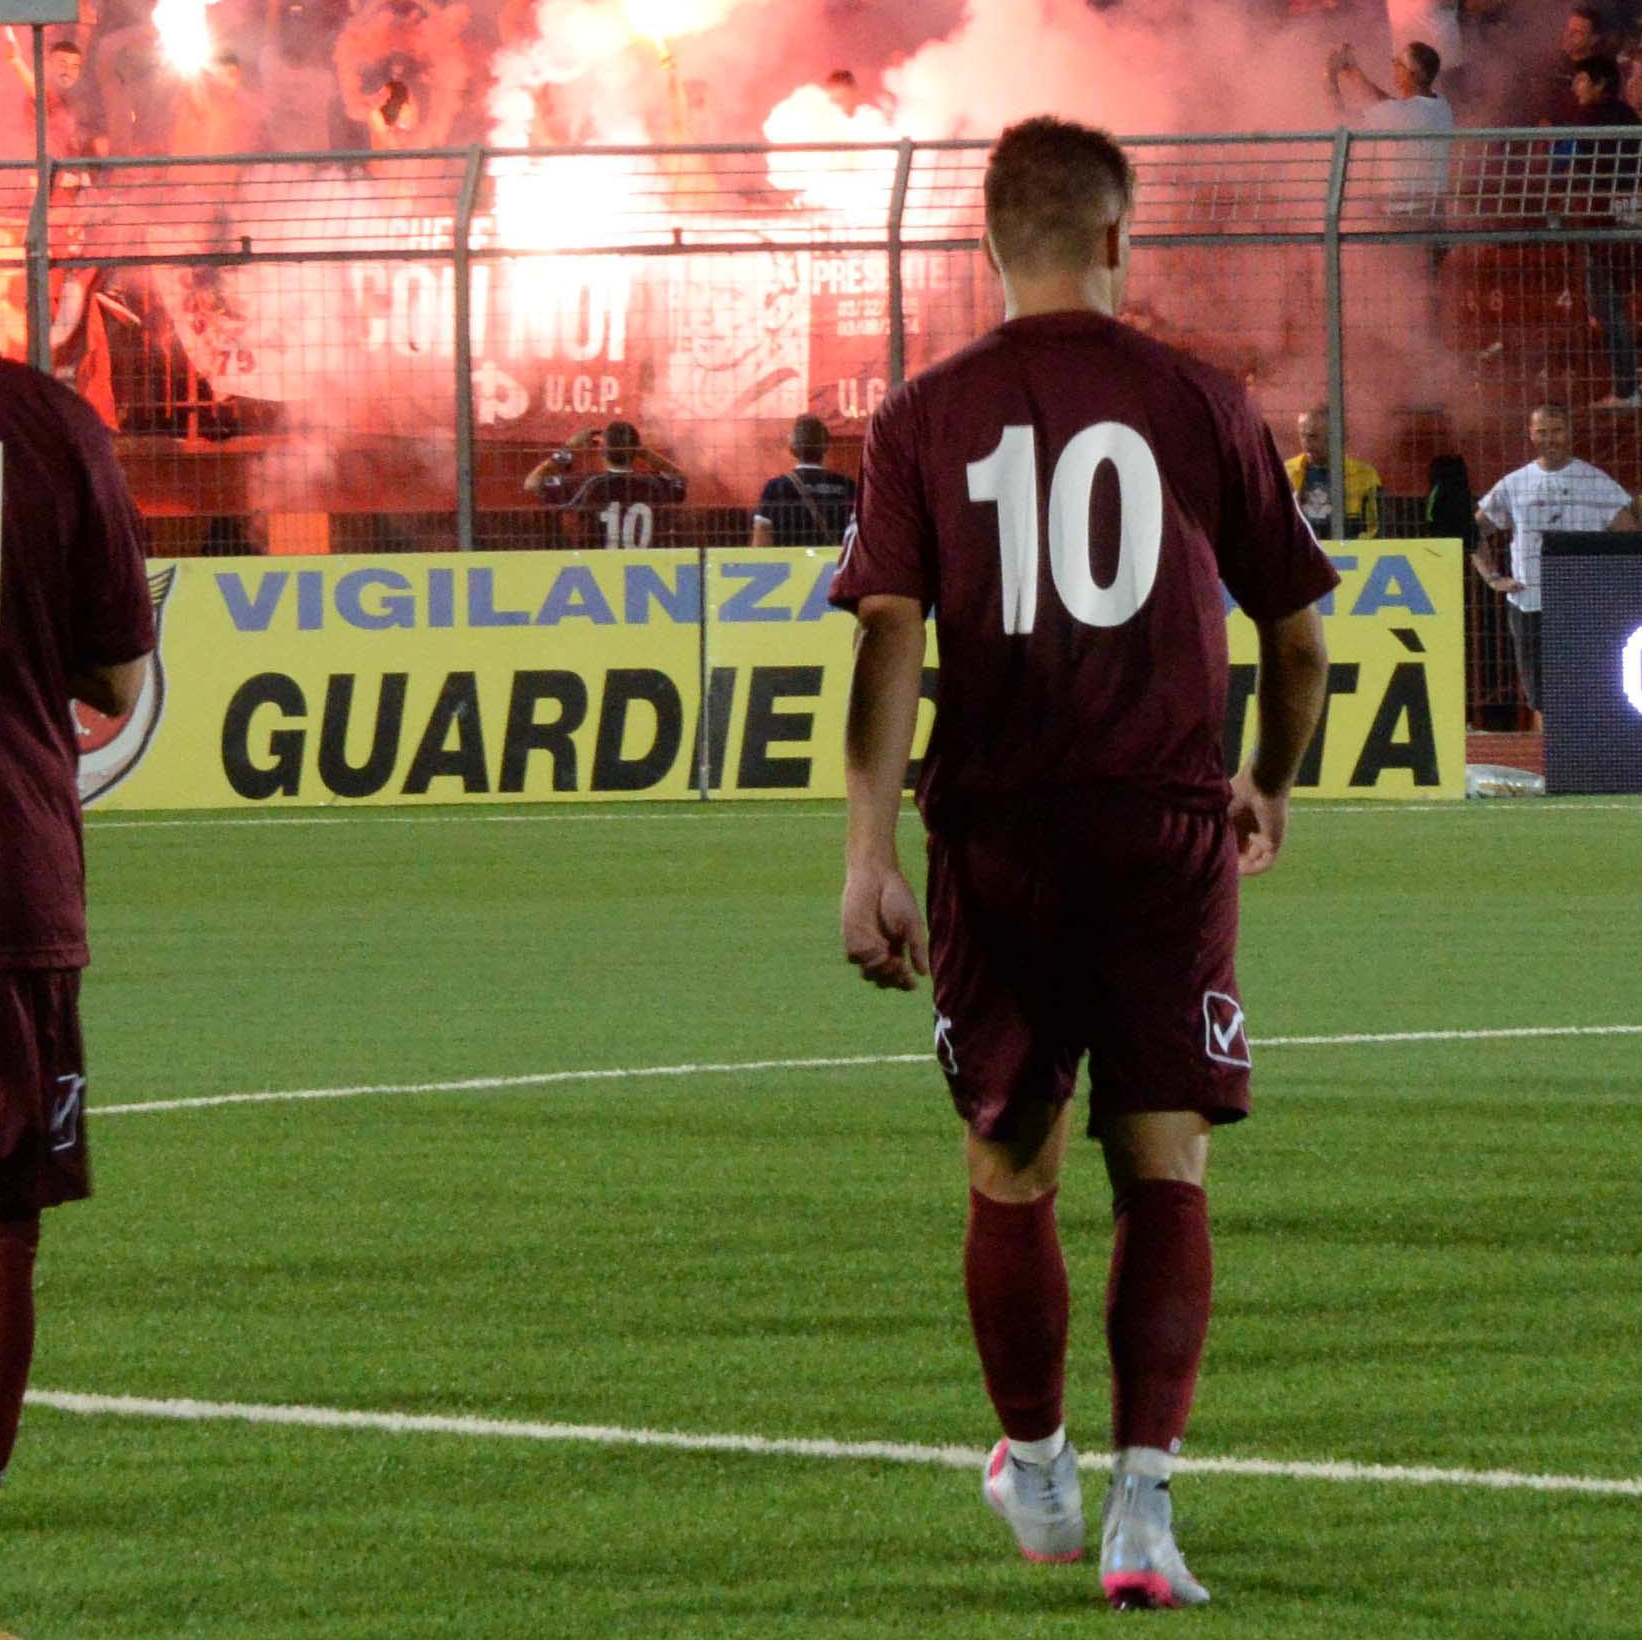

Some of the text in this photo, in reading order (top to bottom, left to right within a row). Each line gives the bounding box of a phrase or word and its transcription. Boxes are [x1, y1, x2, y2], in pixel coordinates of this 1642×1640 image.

[600, 501, 653, 550] 10
[966, 421, 1163, 635] 10
[220, 666, 824, 800] GUARDIE
